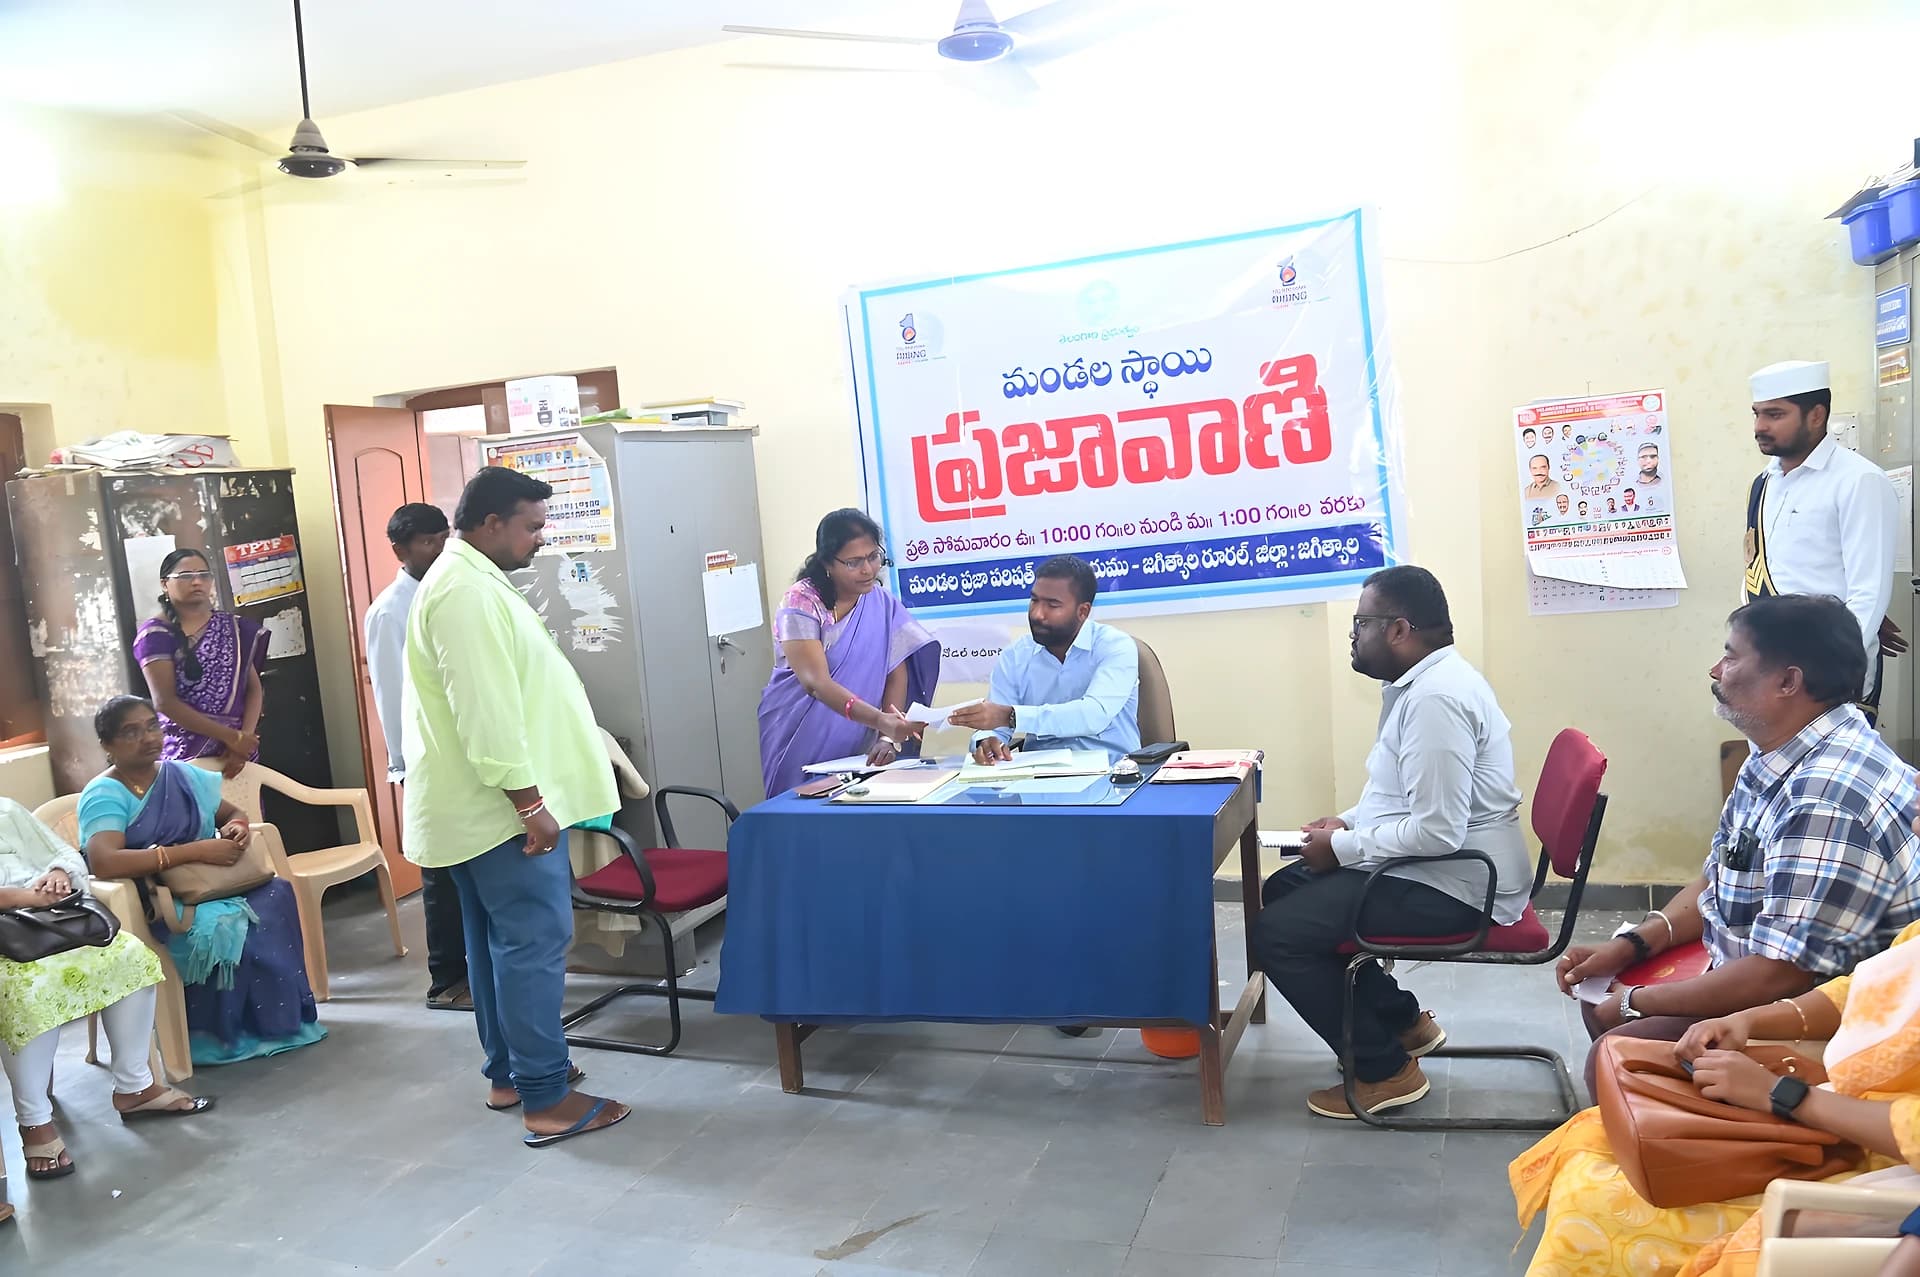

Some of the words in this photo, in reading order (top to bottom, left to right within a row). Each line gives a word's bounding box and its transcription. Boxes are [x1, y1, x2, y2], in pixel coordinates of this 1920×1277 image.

[1002, 357, 1113, 399] మండల
[1120, 347, 1213, 399] స్థాయి
[911, 353, 1333, 523] ప్రజావాణి
[235, 537, 282, 556] TPTF
[905, 539, 930, 562] ప్రతి
[933, 533, 1012, 555] సోమవారం
[1039, 524, 1092, 545] 10:00
[1139, 511, 1183, 535] నుండి
[1218, 507, 1262, 527] 1:00
[1319, 495, 1366, 516] వరకు
[909, 571, 959, 594] మండల
[961, 570, 989, 597] ప్రజా
[990, 561, 1037, 590] పరిషత్
[1142, 550, 1200, 580] జగిత్యాల
[1255, 543, 1289, 568] జిల్లా
[1297, 536, 1360, 565] జగిత్యాల
